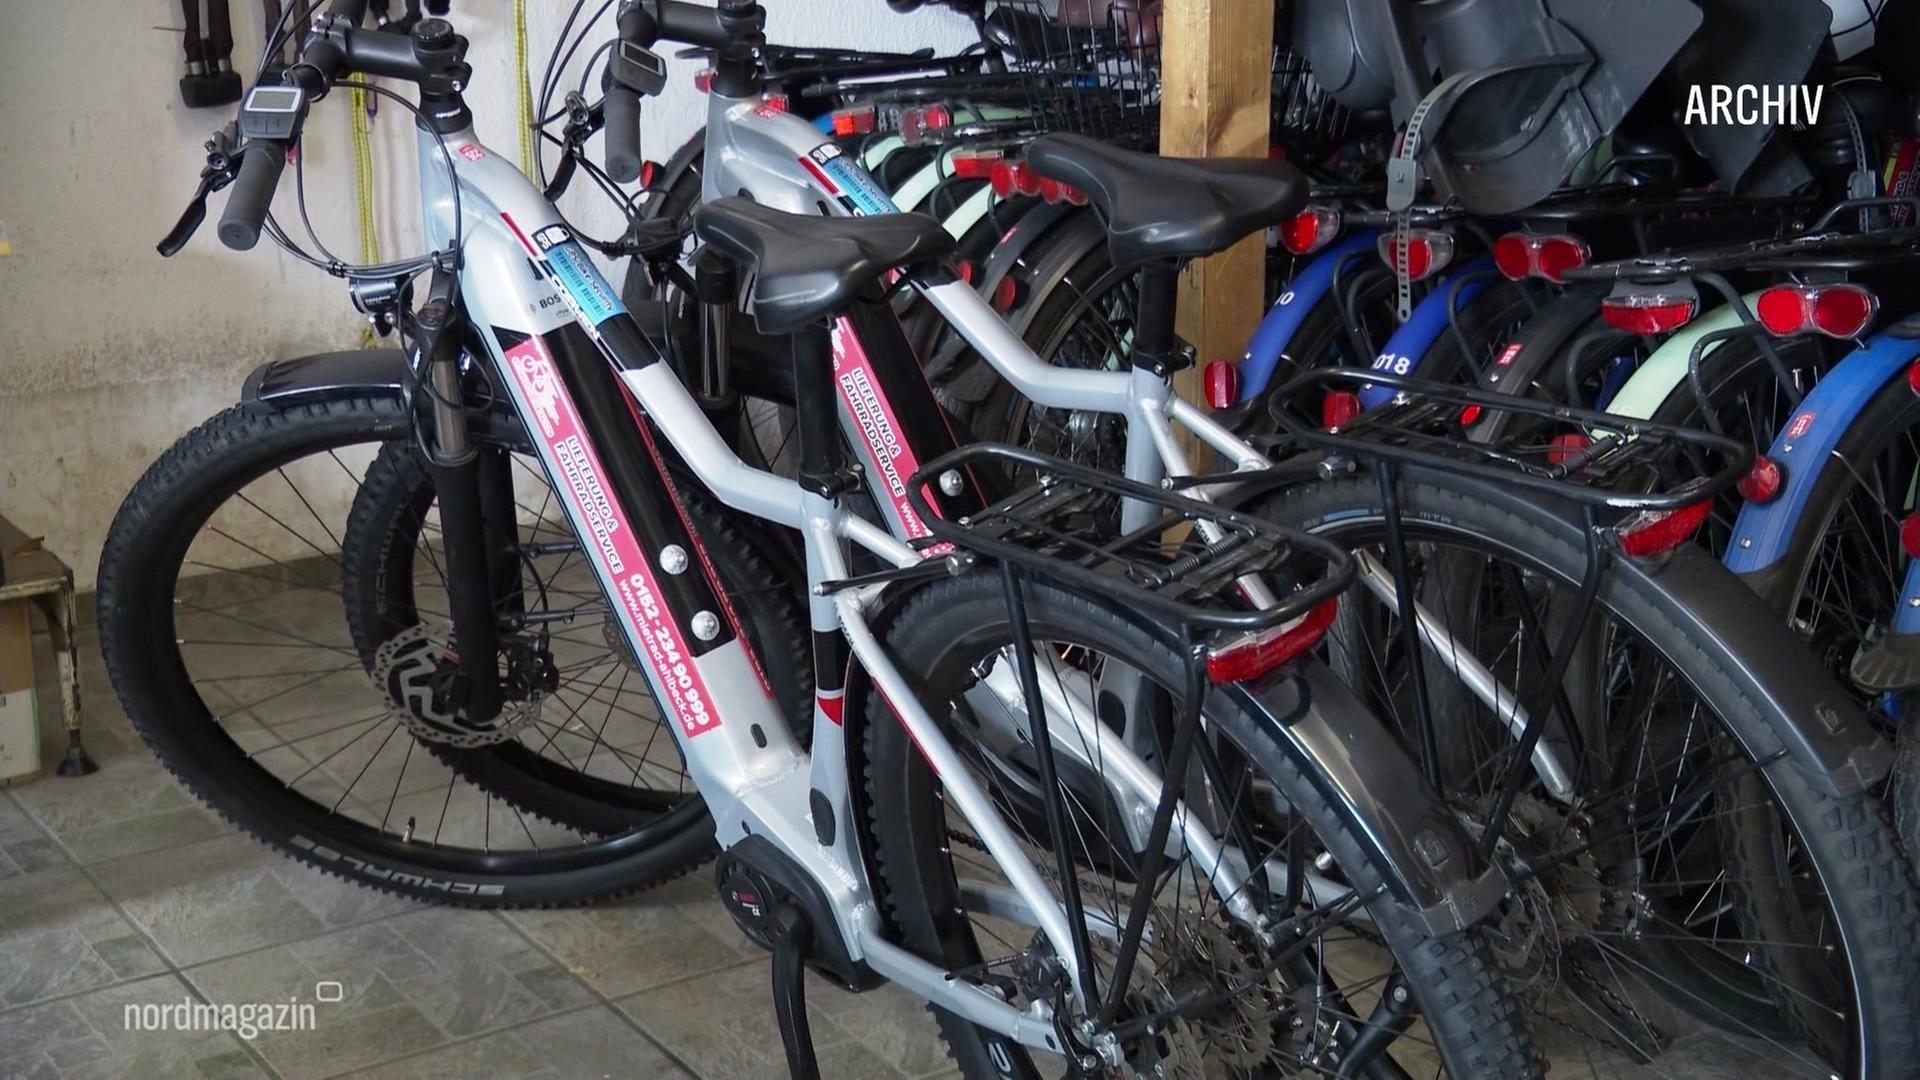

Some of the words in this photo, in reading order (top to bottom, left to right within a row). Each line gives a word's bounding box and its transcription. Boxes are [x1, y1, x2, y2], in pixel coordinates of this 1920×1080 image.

[841, 375, 905, 497] FAHRRADSERVICE
[853, 368, 893, 444] LIEFERUNG
[890, 445, 901, 458] &
[556, 443, 622, 573] FAHRRADSERVICE
[567, 437, 611, 517] LIEFERUNG
[606, 519, 617, 531] &
[619, 578, 696, 731] www.mietrad-ahlbeck.de
[630, 573, 660, 620] 0152
[655, 626, 681, 664] 234
[673, 662, 693, 689] 90
[685, 687, 711, 726] 999
